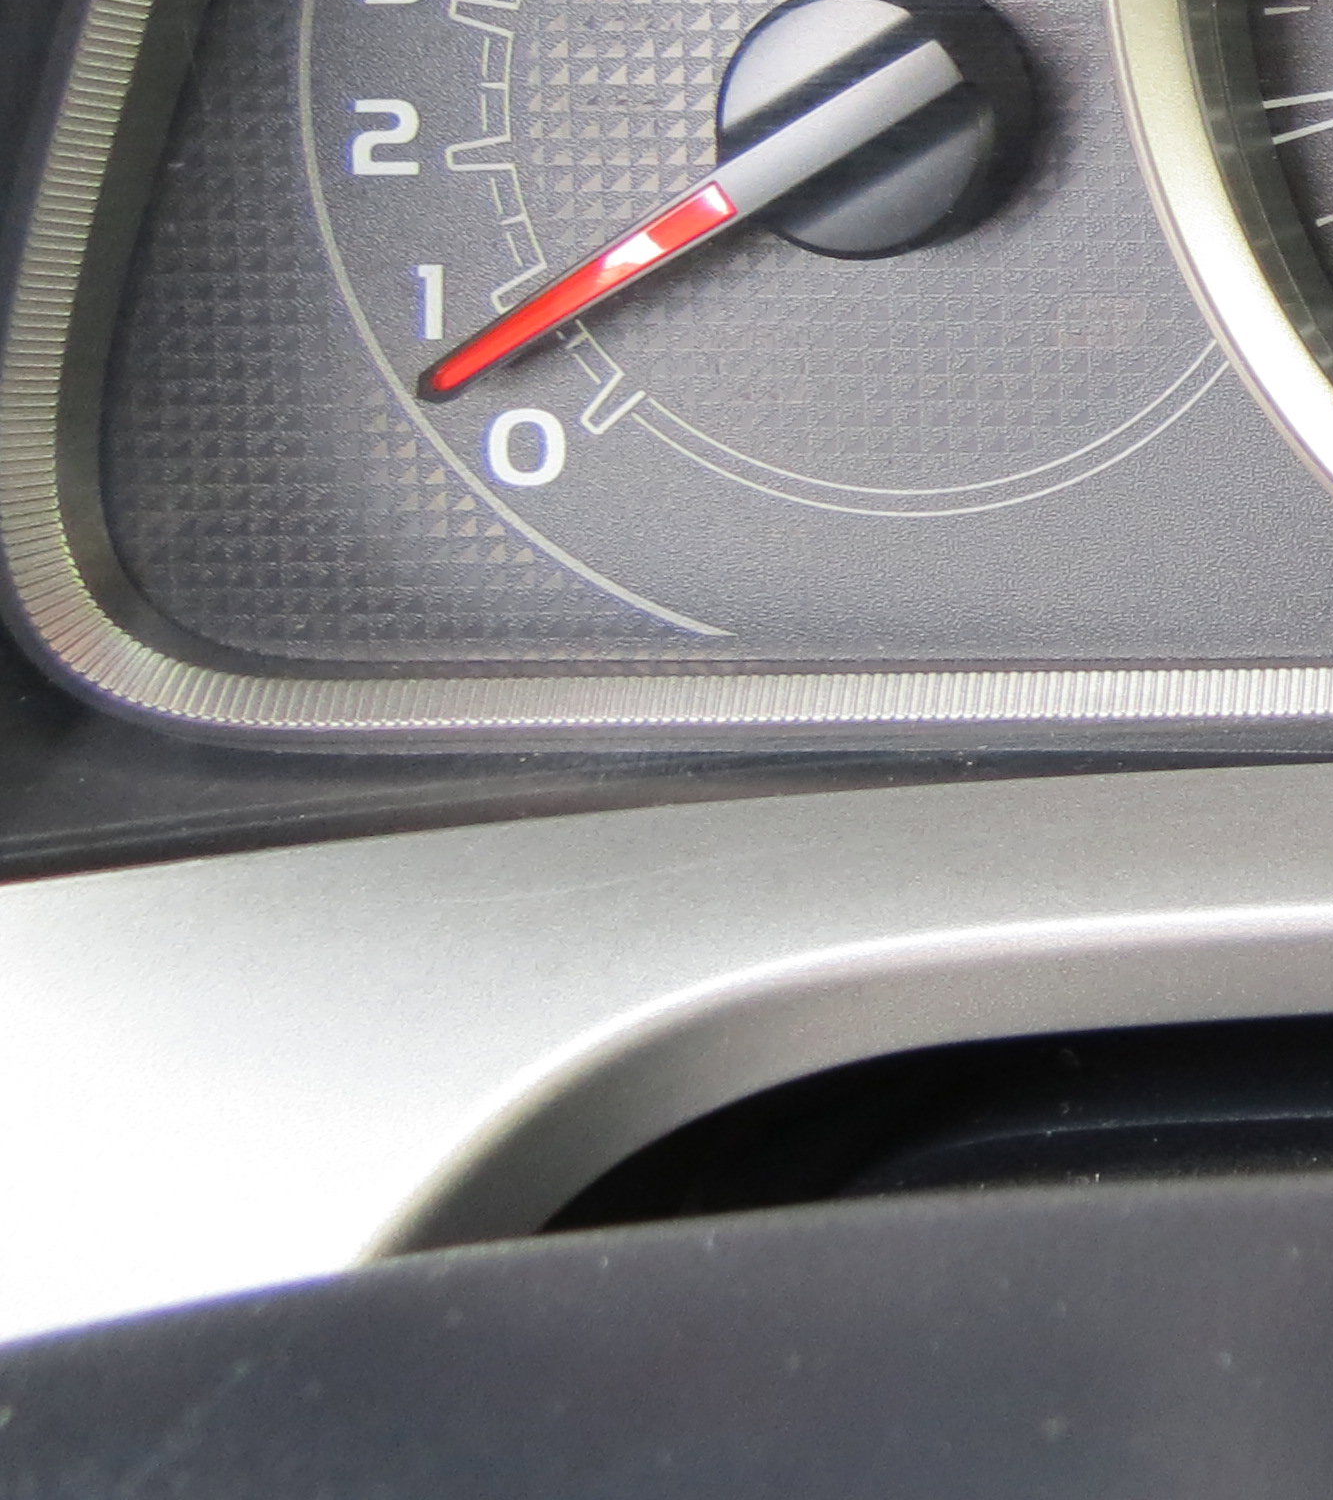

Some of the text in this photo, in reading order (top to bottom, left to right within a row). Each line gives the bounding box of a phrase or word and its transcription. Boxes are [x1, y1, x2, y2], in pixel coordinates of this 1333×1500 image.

[351, 98, 420, 176] 2
[417, 263, 444, 341] 1
[487, 407, 567, 487] 0
